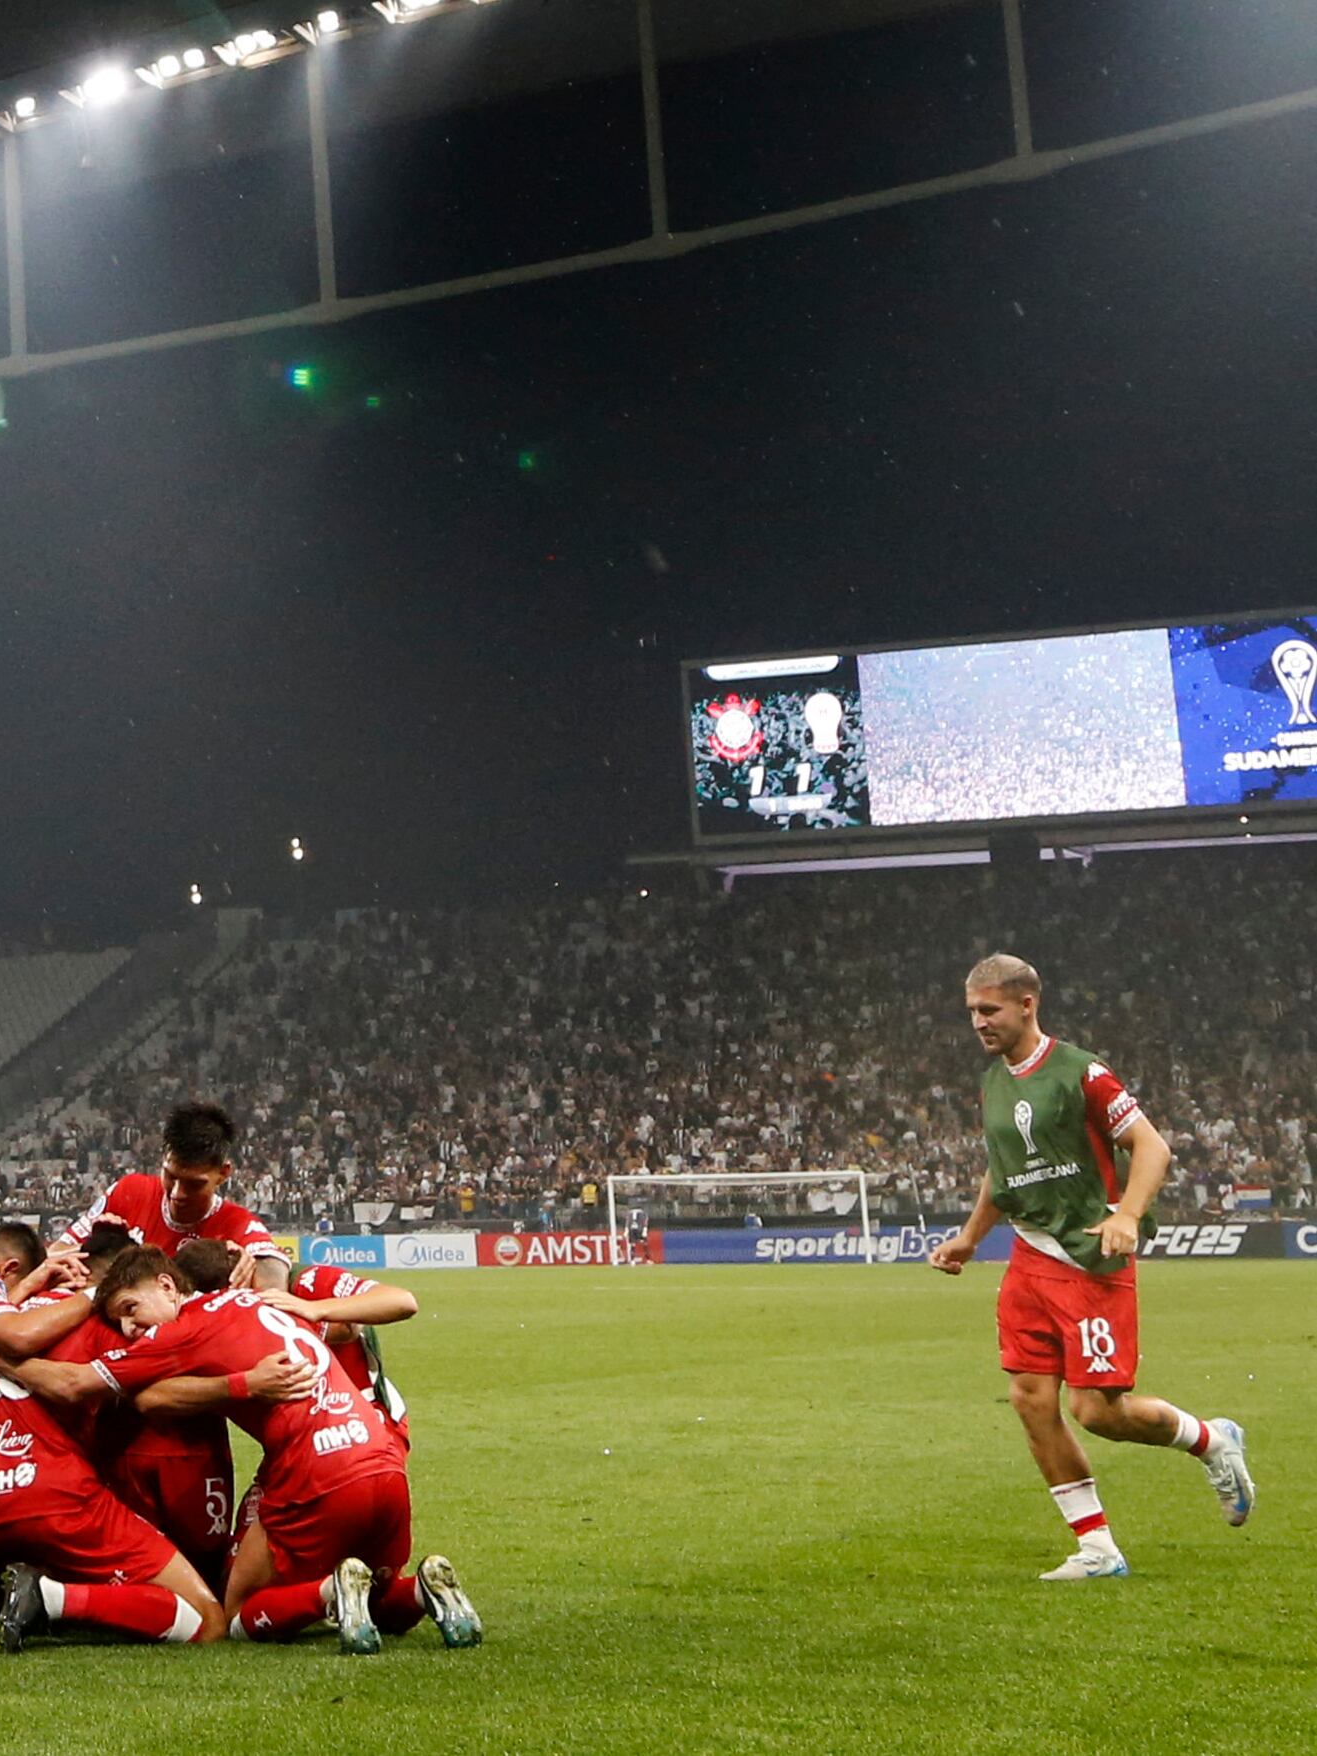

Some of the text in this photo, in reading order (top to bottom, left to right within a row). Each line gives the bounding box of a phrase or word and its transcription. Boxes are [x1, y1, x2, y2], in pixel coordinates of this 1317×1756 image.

[324, 1247, 377, 1264] Midea
[411, 1246, 465, 1263] Midea
[756, 1226, 962, 1264] sportingbe
[1077, 1317, 1116, 1358] 18
[205, 1477, 228, 1518] 5
